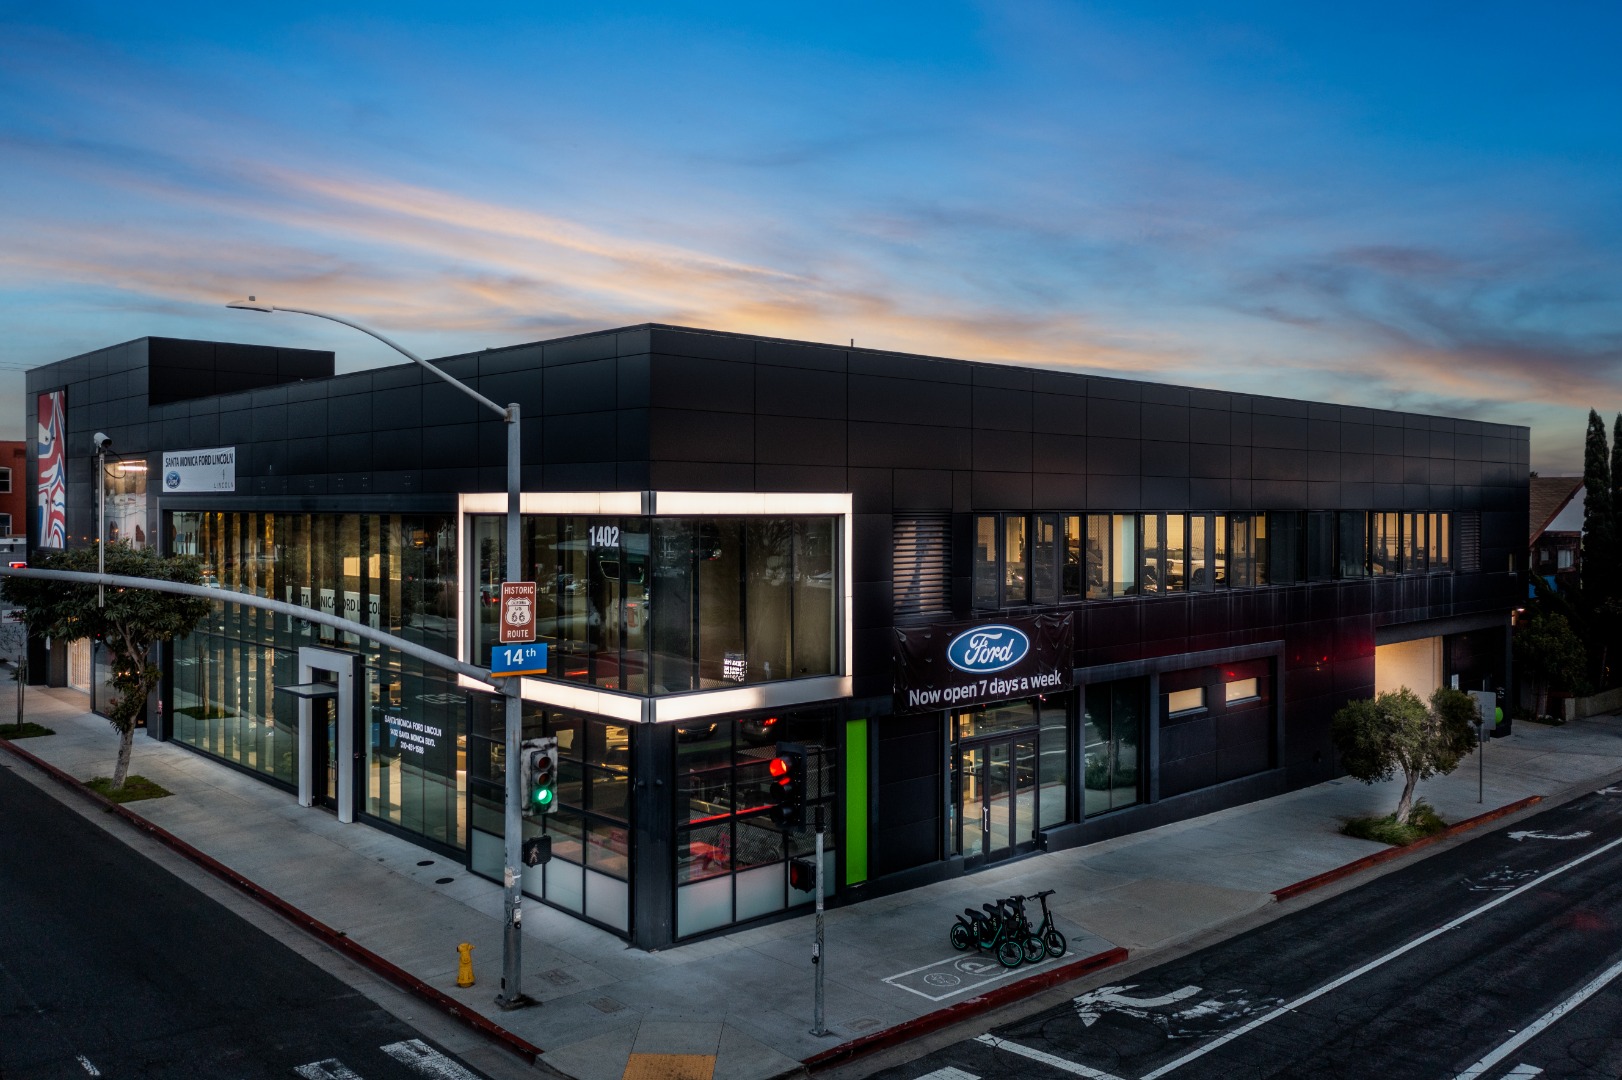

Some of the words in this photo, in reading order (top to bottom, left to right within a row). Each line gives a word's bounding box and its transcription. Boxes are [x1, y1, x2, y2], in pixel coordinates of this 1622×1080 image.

[165, 457, 180, 467] SANTA
[180, 456, 198, 467] MONICA
[198, 455, 211, 466] FORD
[212, 453, 234, 465] LINCOLN
[589, 525, 619, 548] 1402
[504, 586, 534, 595] HISTORIC
[320, 595, 335, 608] NICA
[511, 612, 526, 622] 66
[507, 629, 529, 638] ROUTE
[964, 632, 1015, 666] Ford
[503, 648, 537, 666] 14th
[909, 688, 942, 707] Now
[943, 683, 977, 703] open
[979, 680, 988, 697] 7
[989, 677, 1019, 696] days
[1020, 678, 1029, 691] a
[1030, 669, 1063, 688] week
[413, 722, 423, 731] FORD
[424, 725, 441, 736] LINCOLN
